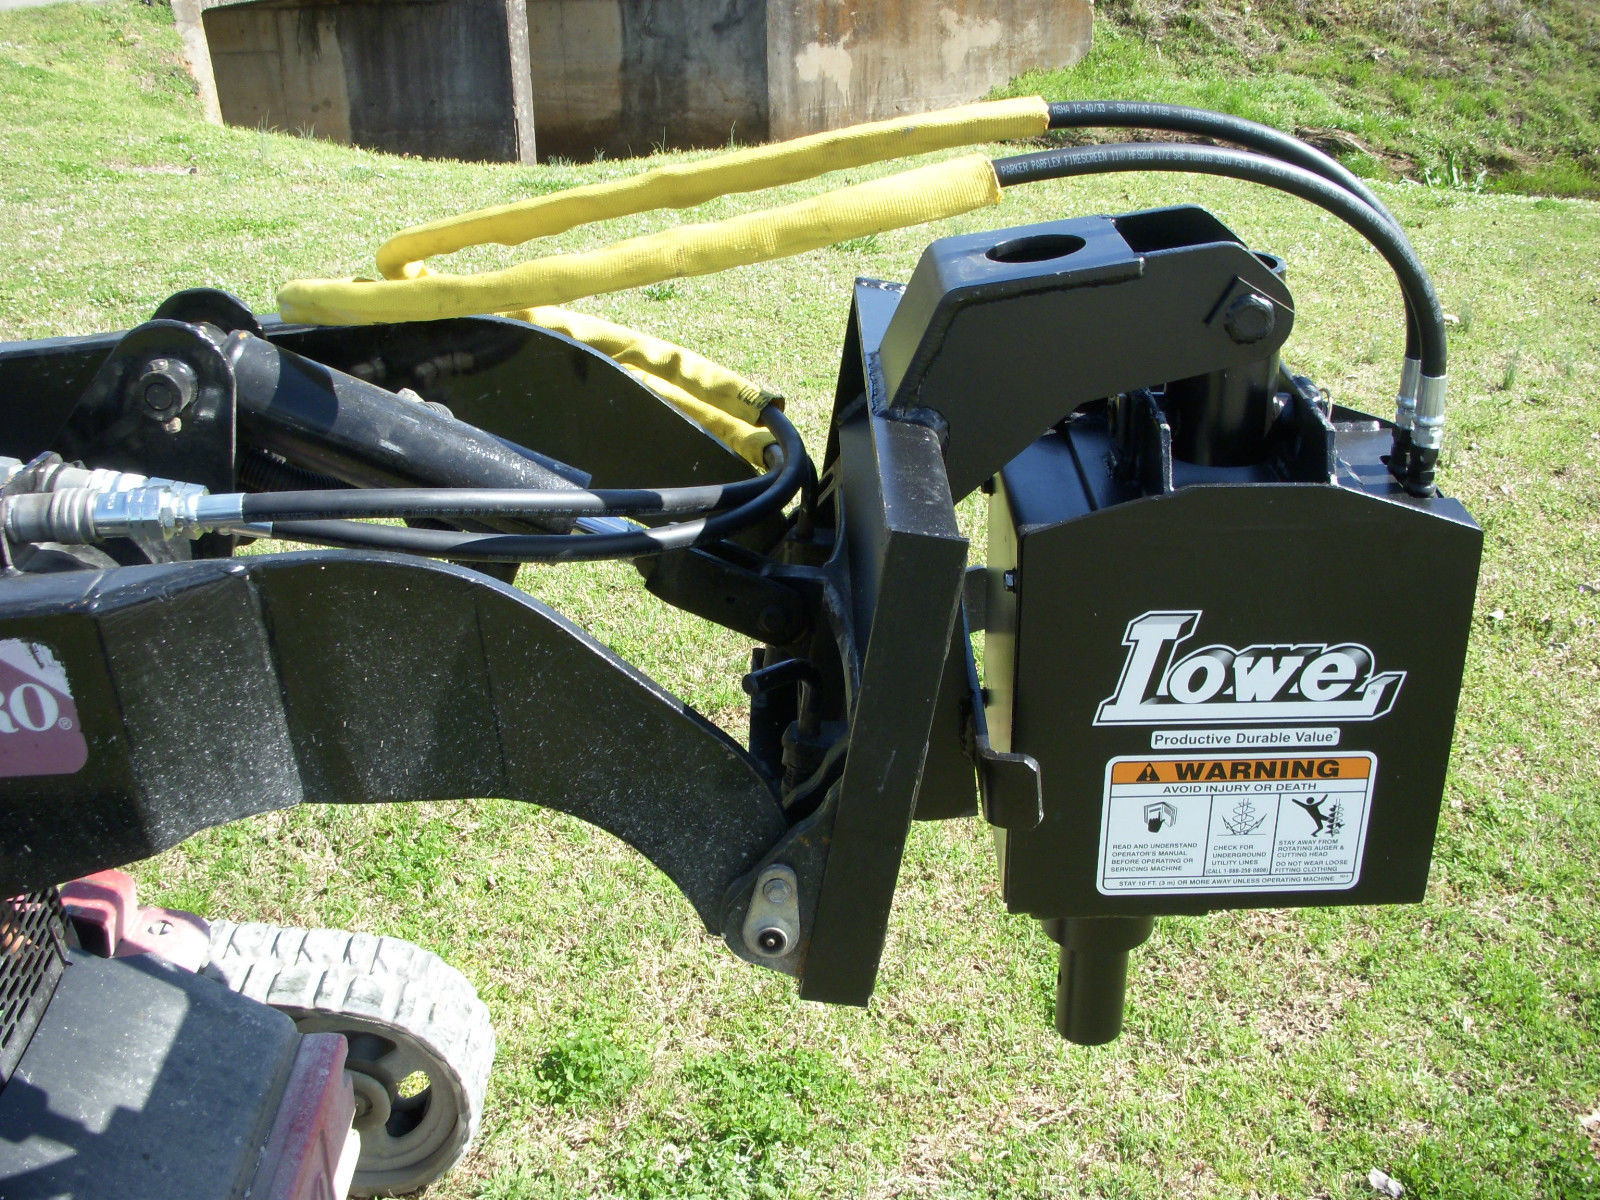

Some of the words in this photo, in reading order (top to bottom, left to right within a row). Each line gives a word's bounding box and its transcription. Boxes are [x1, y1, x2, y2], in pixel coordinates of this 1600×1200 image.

[1000, 162, 1028, 176] PARKER
[1031, 156, 1061, 170] PARFLEX
[1063, 151, 1108, 166] FIRESCREEN
[1093, 610, 1406, 725] Lowe
[1154, 733, 1231, 746] Productive
[1236, 732, 1291, 744] Durable
[1174, 759, 1340, 781] WARNING
[1163, 785, 1202, 794] AVOID
[1205, 784, 1251, 793] INJURY
[1254, 784, 1272, 792] OR
[1276, 783, 1317, 791] DEATH
